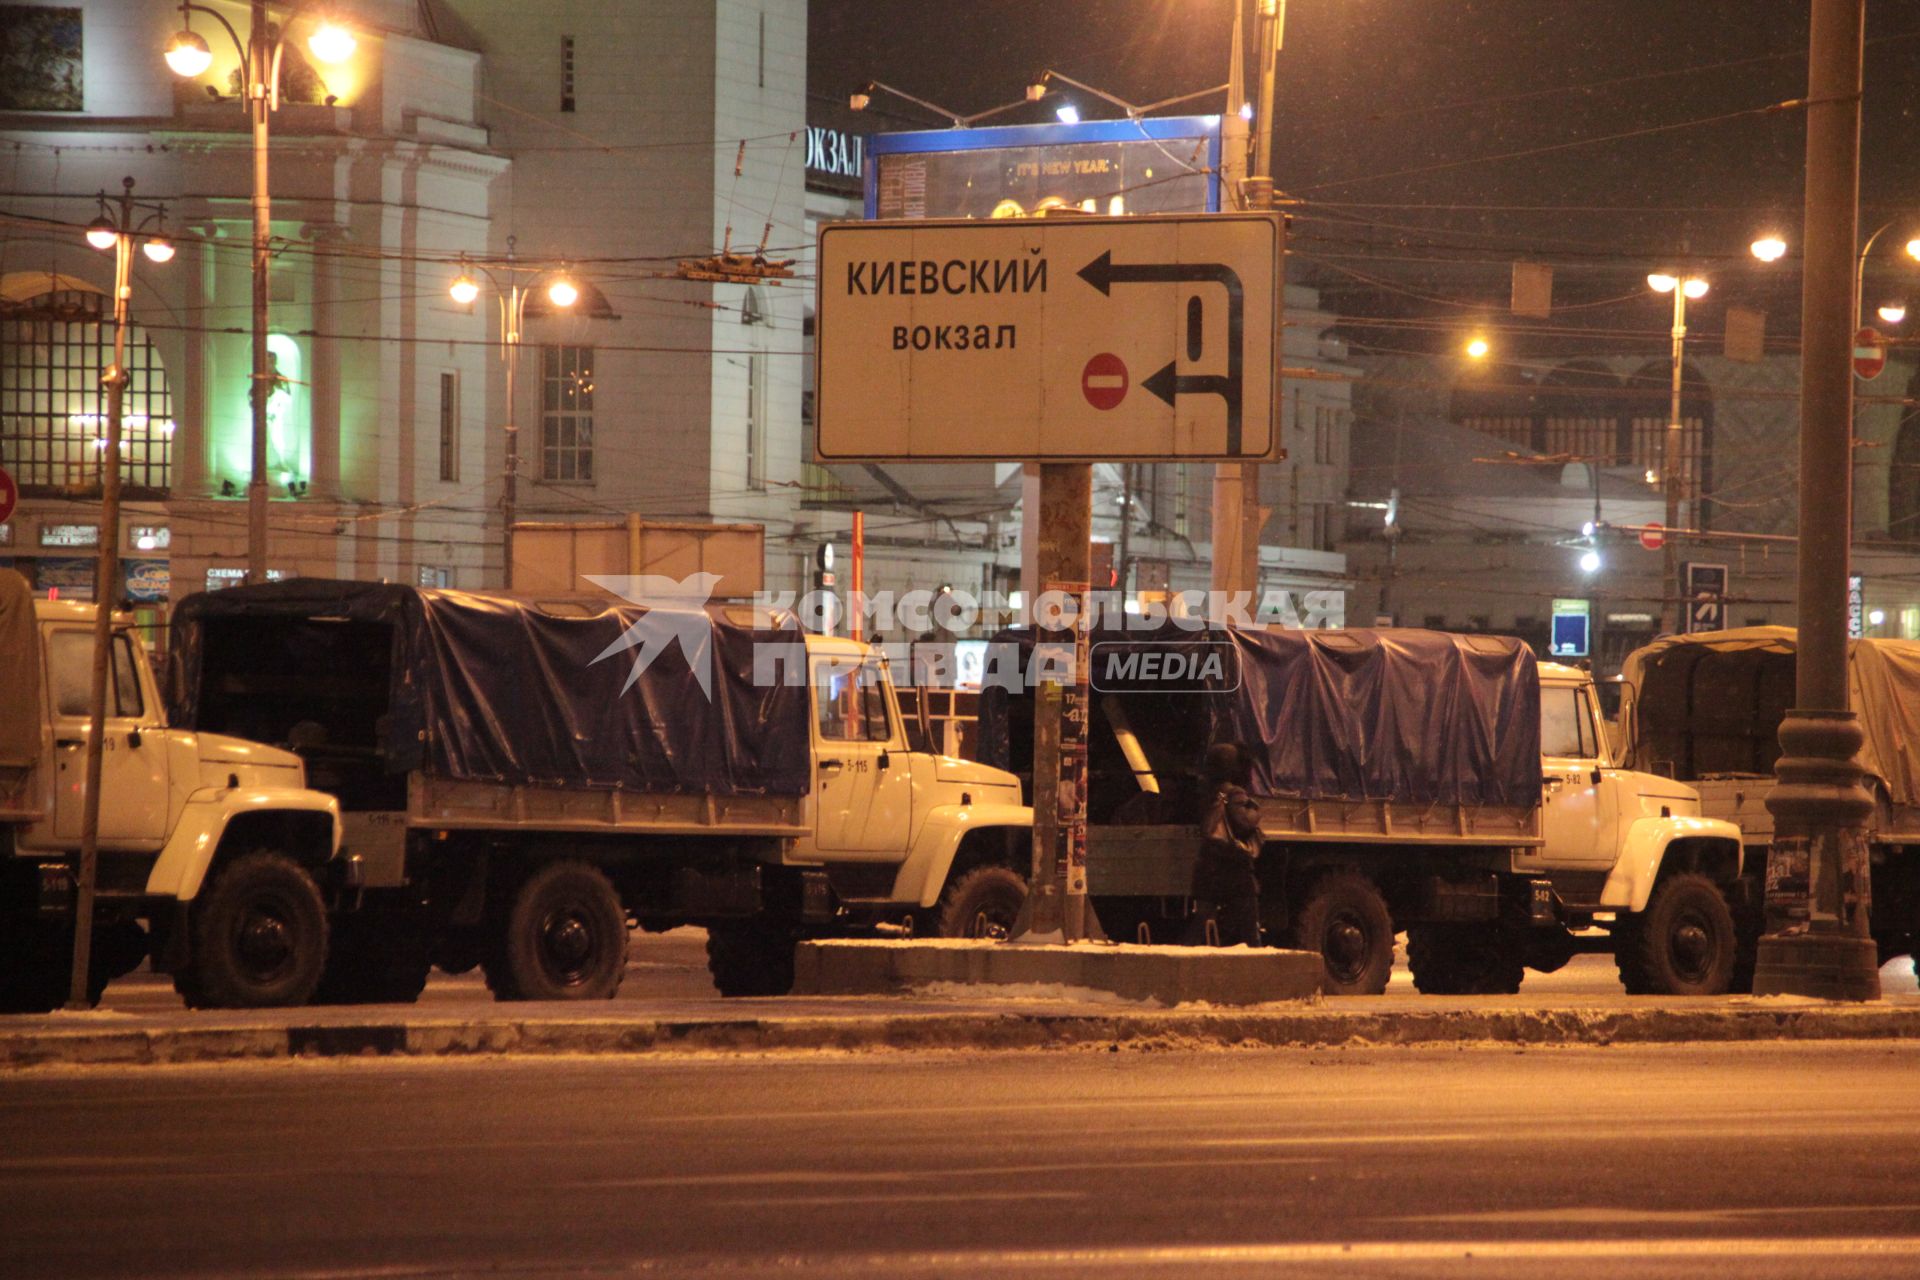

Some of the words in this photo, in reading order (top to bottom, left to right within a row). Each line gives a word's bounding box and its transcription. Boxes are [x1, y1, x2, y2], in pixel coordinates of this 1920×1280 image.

[1042, 161, 1071, 176] NEW
[847, 247, 1047, 296] КИЕВСКИЙ
[893, 324, 1016, 351] вокзал
[1566, 774, 1581, 784] 5-82
